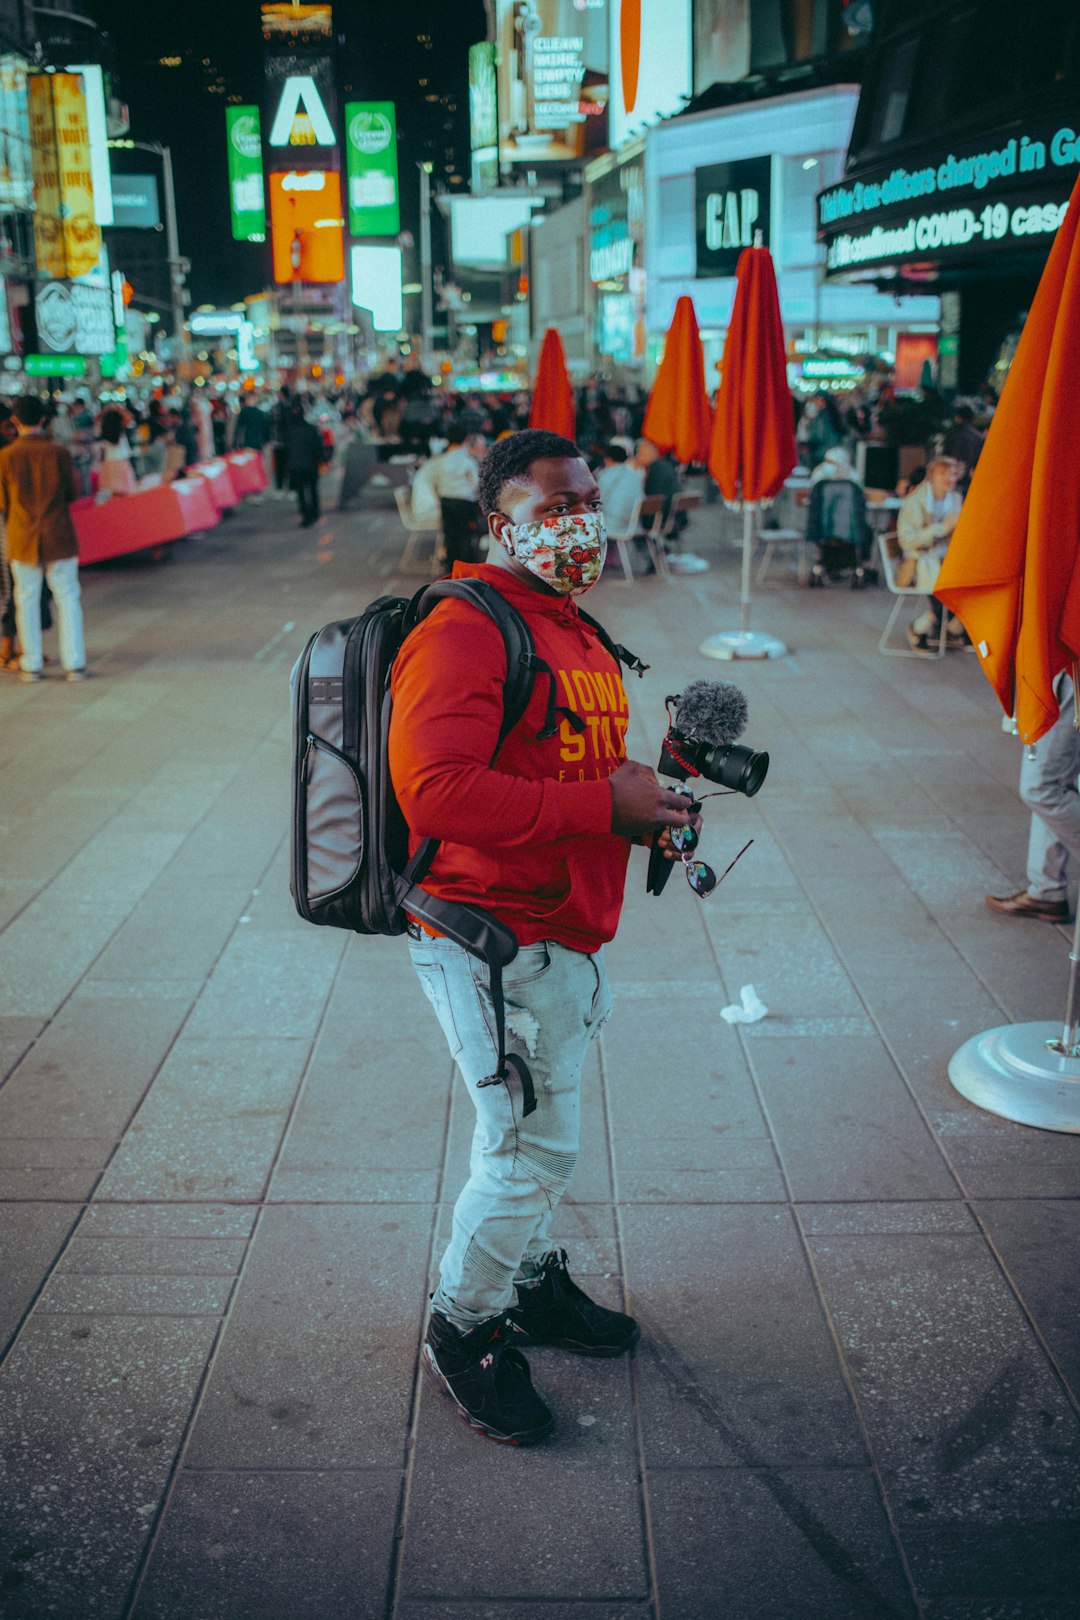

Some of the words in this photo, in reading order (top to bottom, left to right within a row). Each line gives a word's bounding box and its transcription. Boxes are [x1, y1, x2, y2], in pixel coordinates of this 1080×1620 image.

[534, 37, 583, 52] CLEAN
[534, 67, 586, 83] EMPTY
[269, 76, 336, 146] A
[937, 138, 1018, 191] charged
[1020, 136, 1046, 172] in
[706, 188, 759, 250] GAP
[916, 202, 1009, 250] COVID-19
[559, 669, 629, 713] IOWA
[560, 716, 629, 762] STAT
